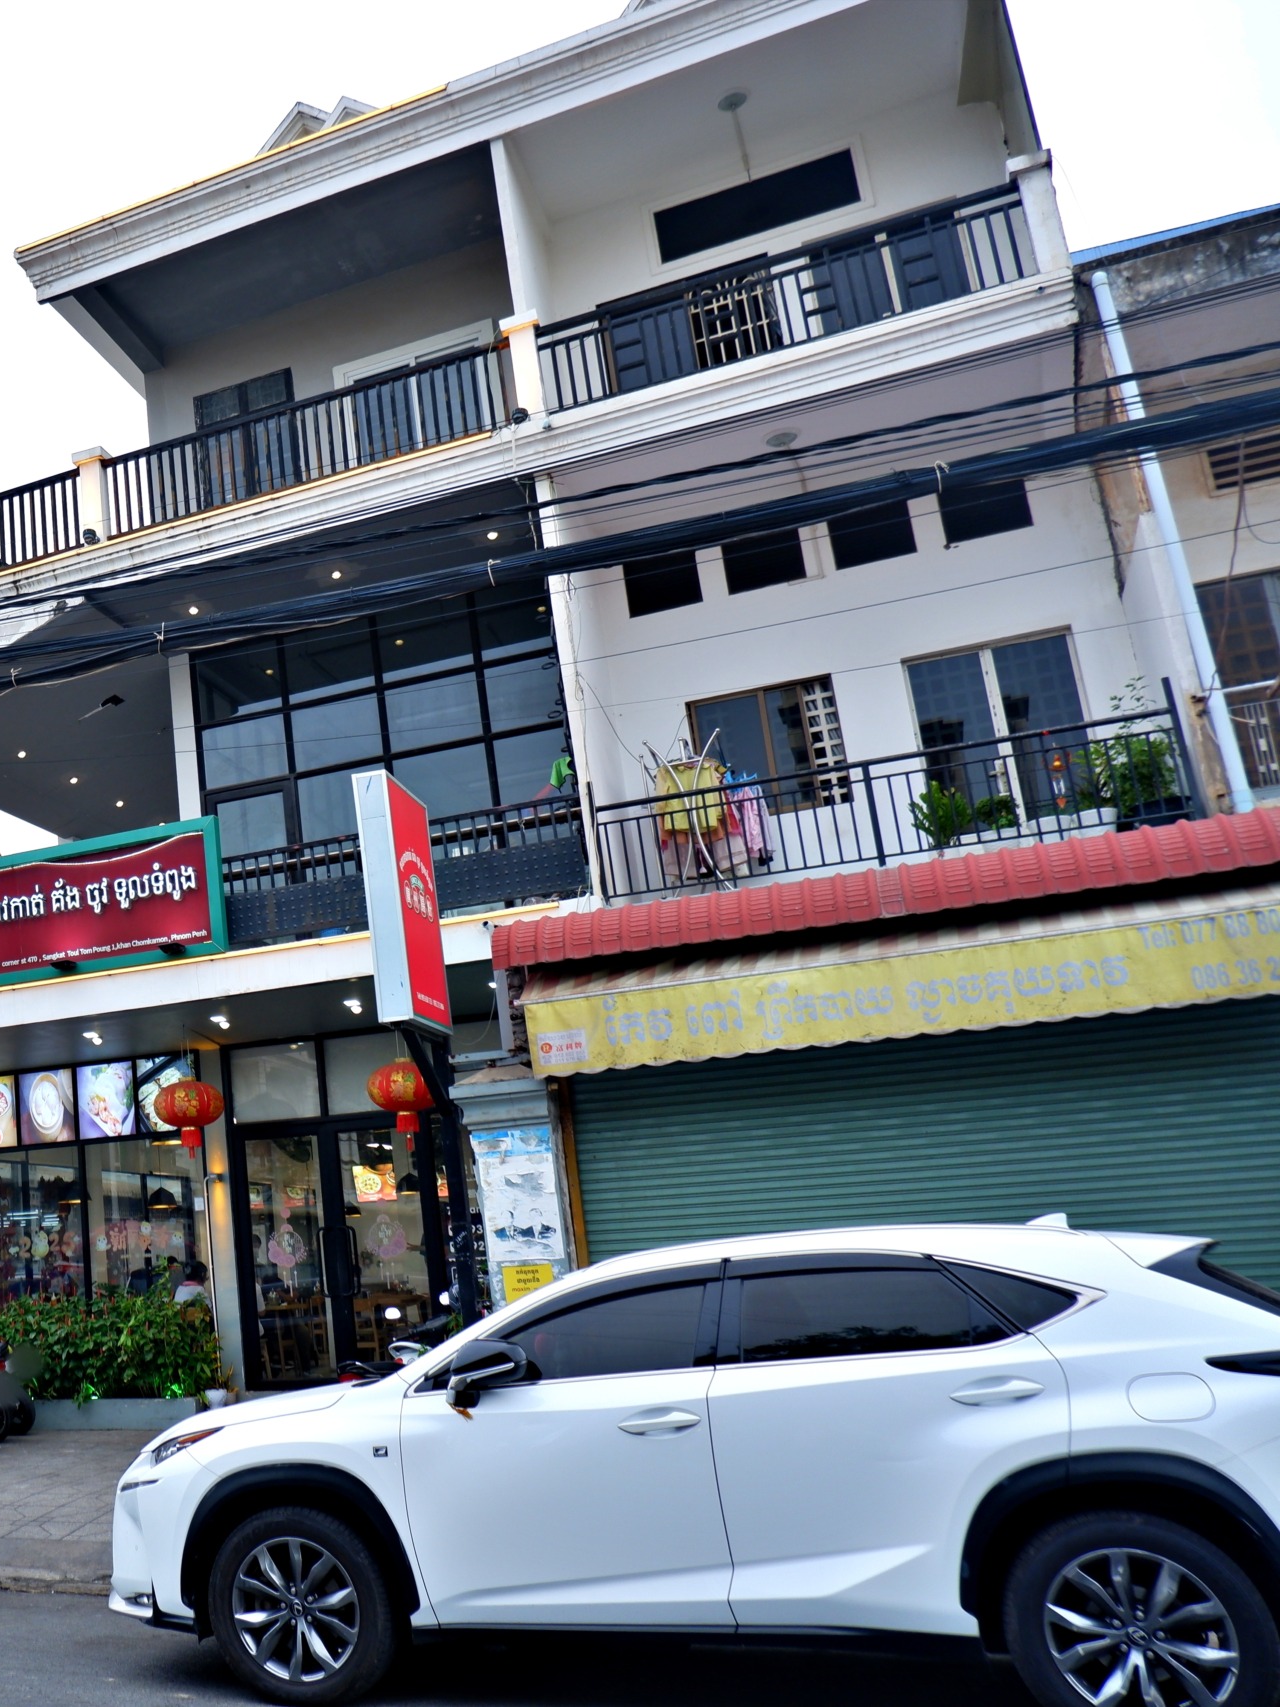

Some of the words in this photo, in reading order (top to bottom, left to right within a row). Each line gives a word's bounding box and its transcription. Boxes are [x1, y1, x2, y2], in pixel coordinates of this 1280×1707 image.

[2, 959, 20, 967] corner
[170, 932, 192, 942] Phnom
[192, 929, 208, 937] Penh
[1137, 924, 1177, 950] Tel:
[1181, 916, 1216, 944] 077
[1224, 912, 1252, 939] 88
[1191, 962, 1231, 990] 086
[1234, 958, 1263, 985] 36
